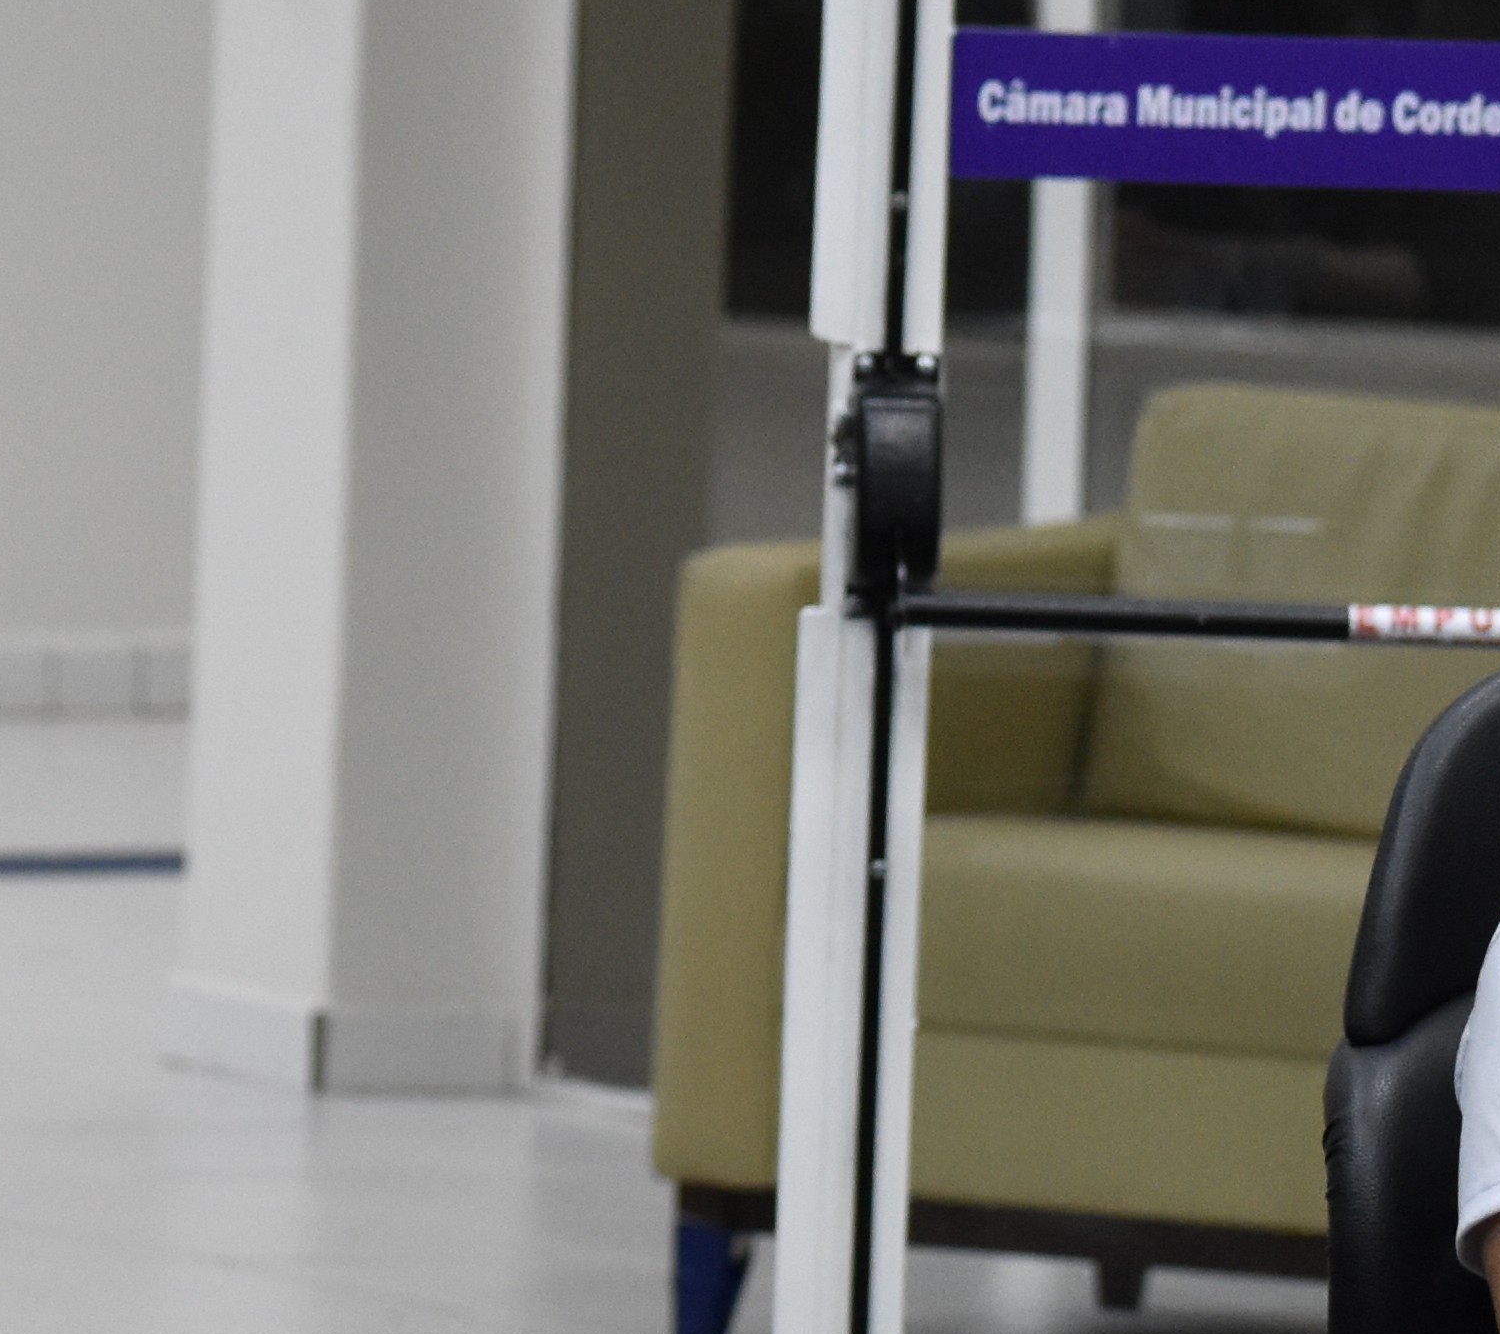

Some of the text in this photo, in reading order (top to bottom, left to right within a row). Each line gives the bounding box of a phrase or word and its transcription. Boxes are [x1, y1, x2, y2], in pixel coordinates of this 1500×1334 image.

[977, 77, 1129, 127] Câmara
[1135, 82, 1328, 140] Municipal
[1333, 88, 1386, 135] de
